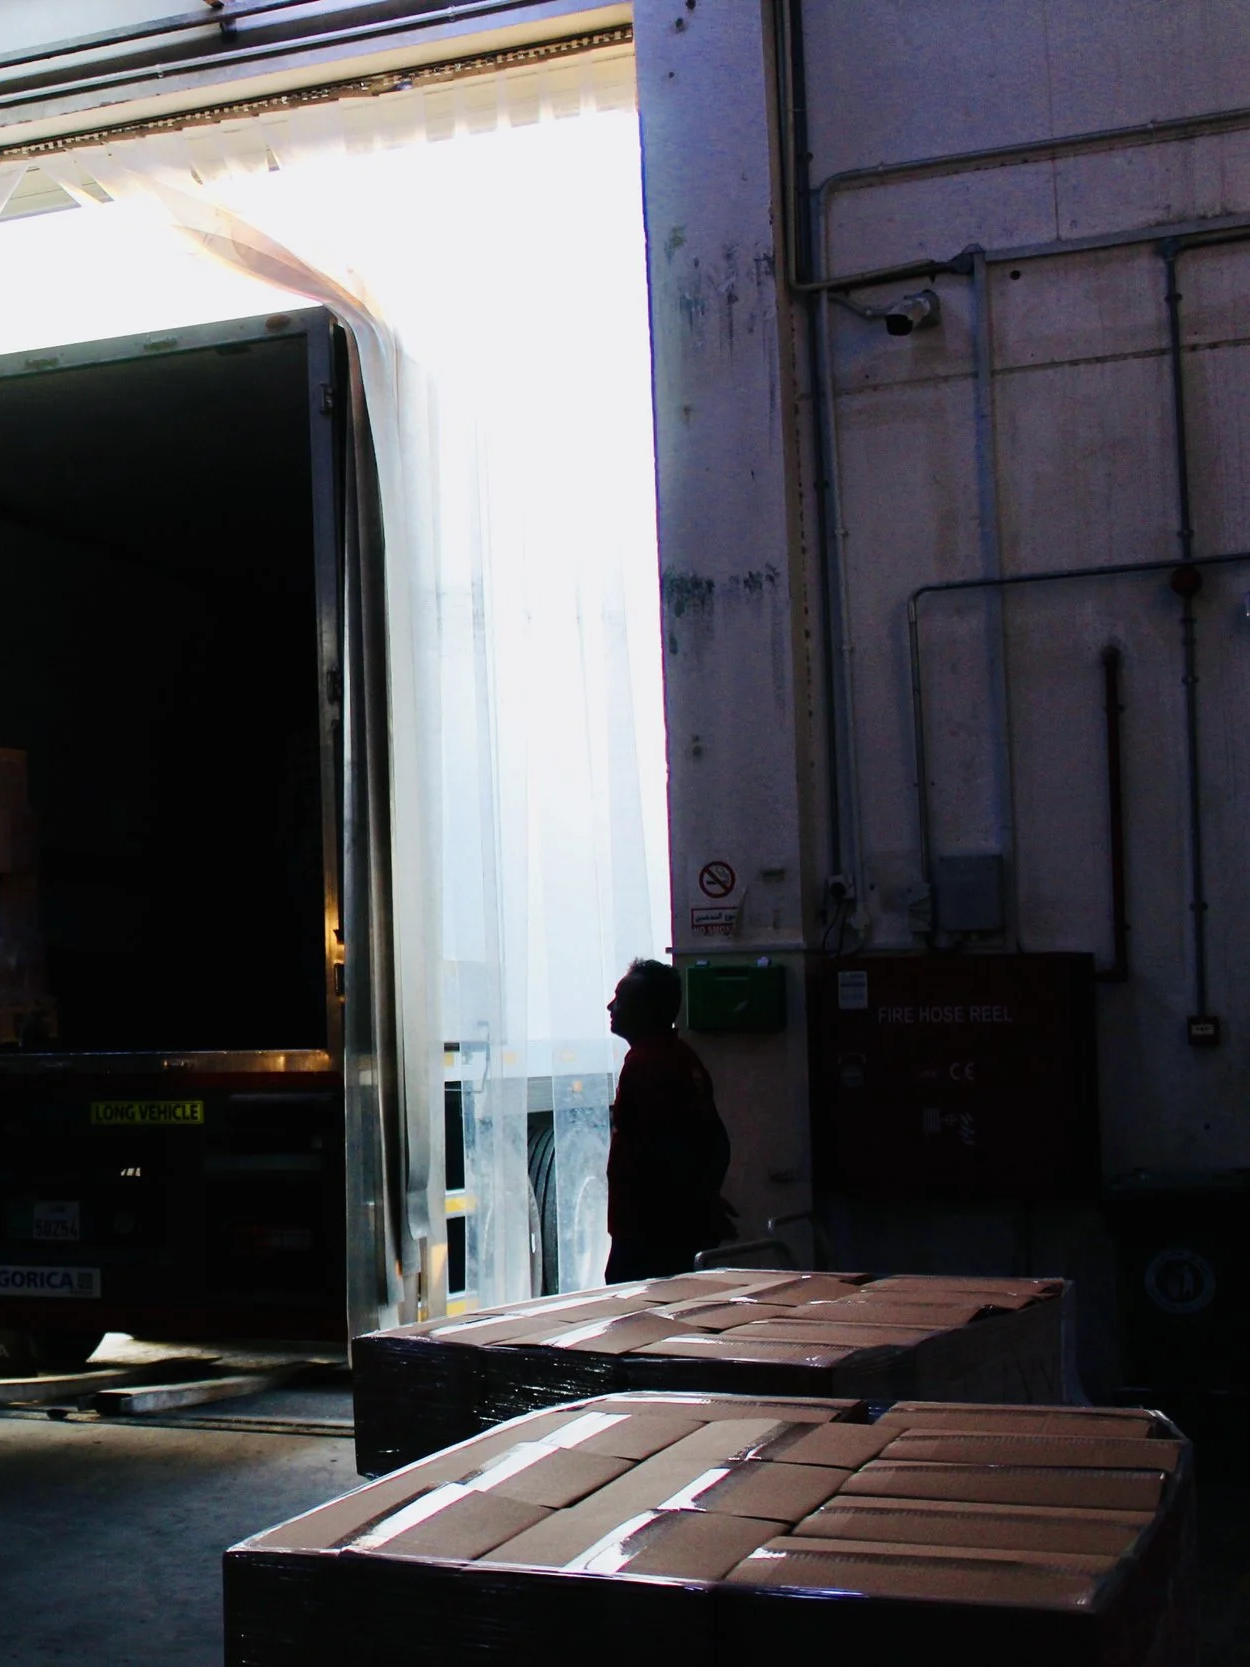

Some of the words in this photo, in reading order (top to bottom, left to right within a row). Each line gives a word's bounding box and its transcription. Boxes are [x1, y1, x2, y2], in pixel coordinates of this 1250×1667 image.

[878, 1006, 914, 1024] FIRE
[919, 1005, 964, 1024] HOSE
[969, 1004, 1013, 1023] REEL
[95, 1104, 136, 1121] LONG
[138, 1103, 199, 1120] VEHICLE
